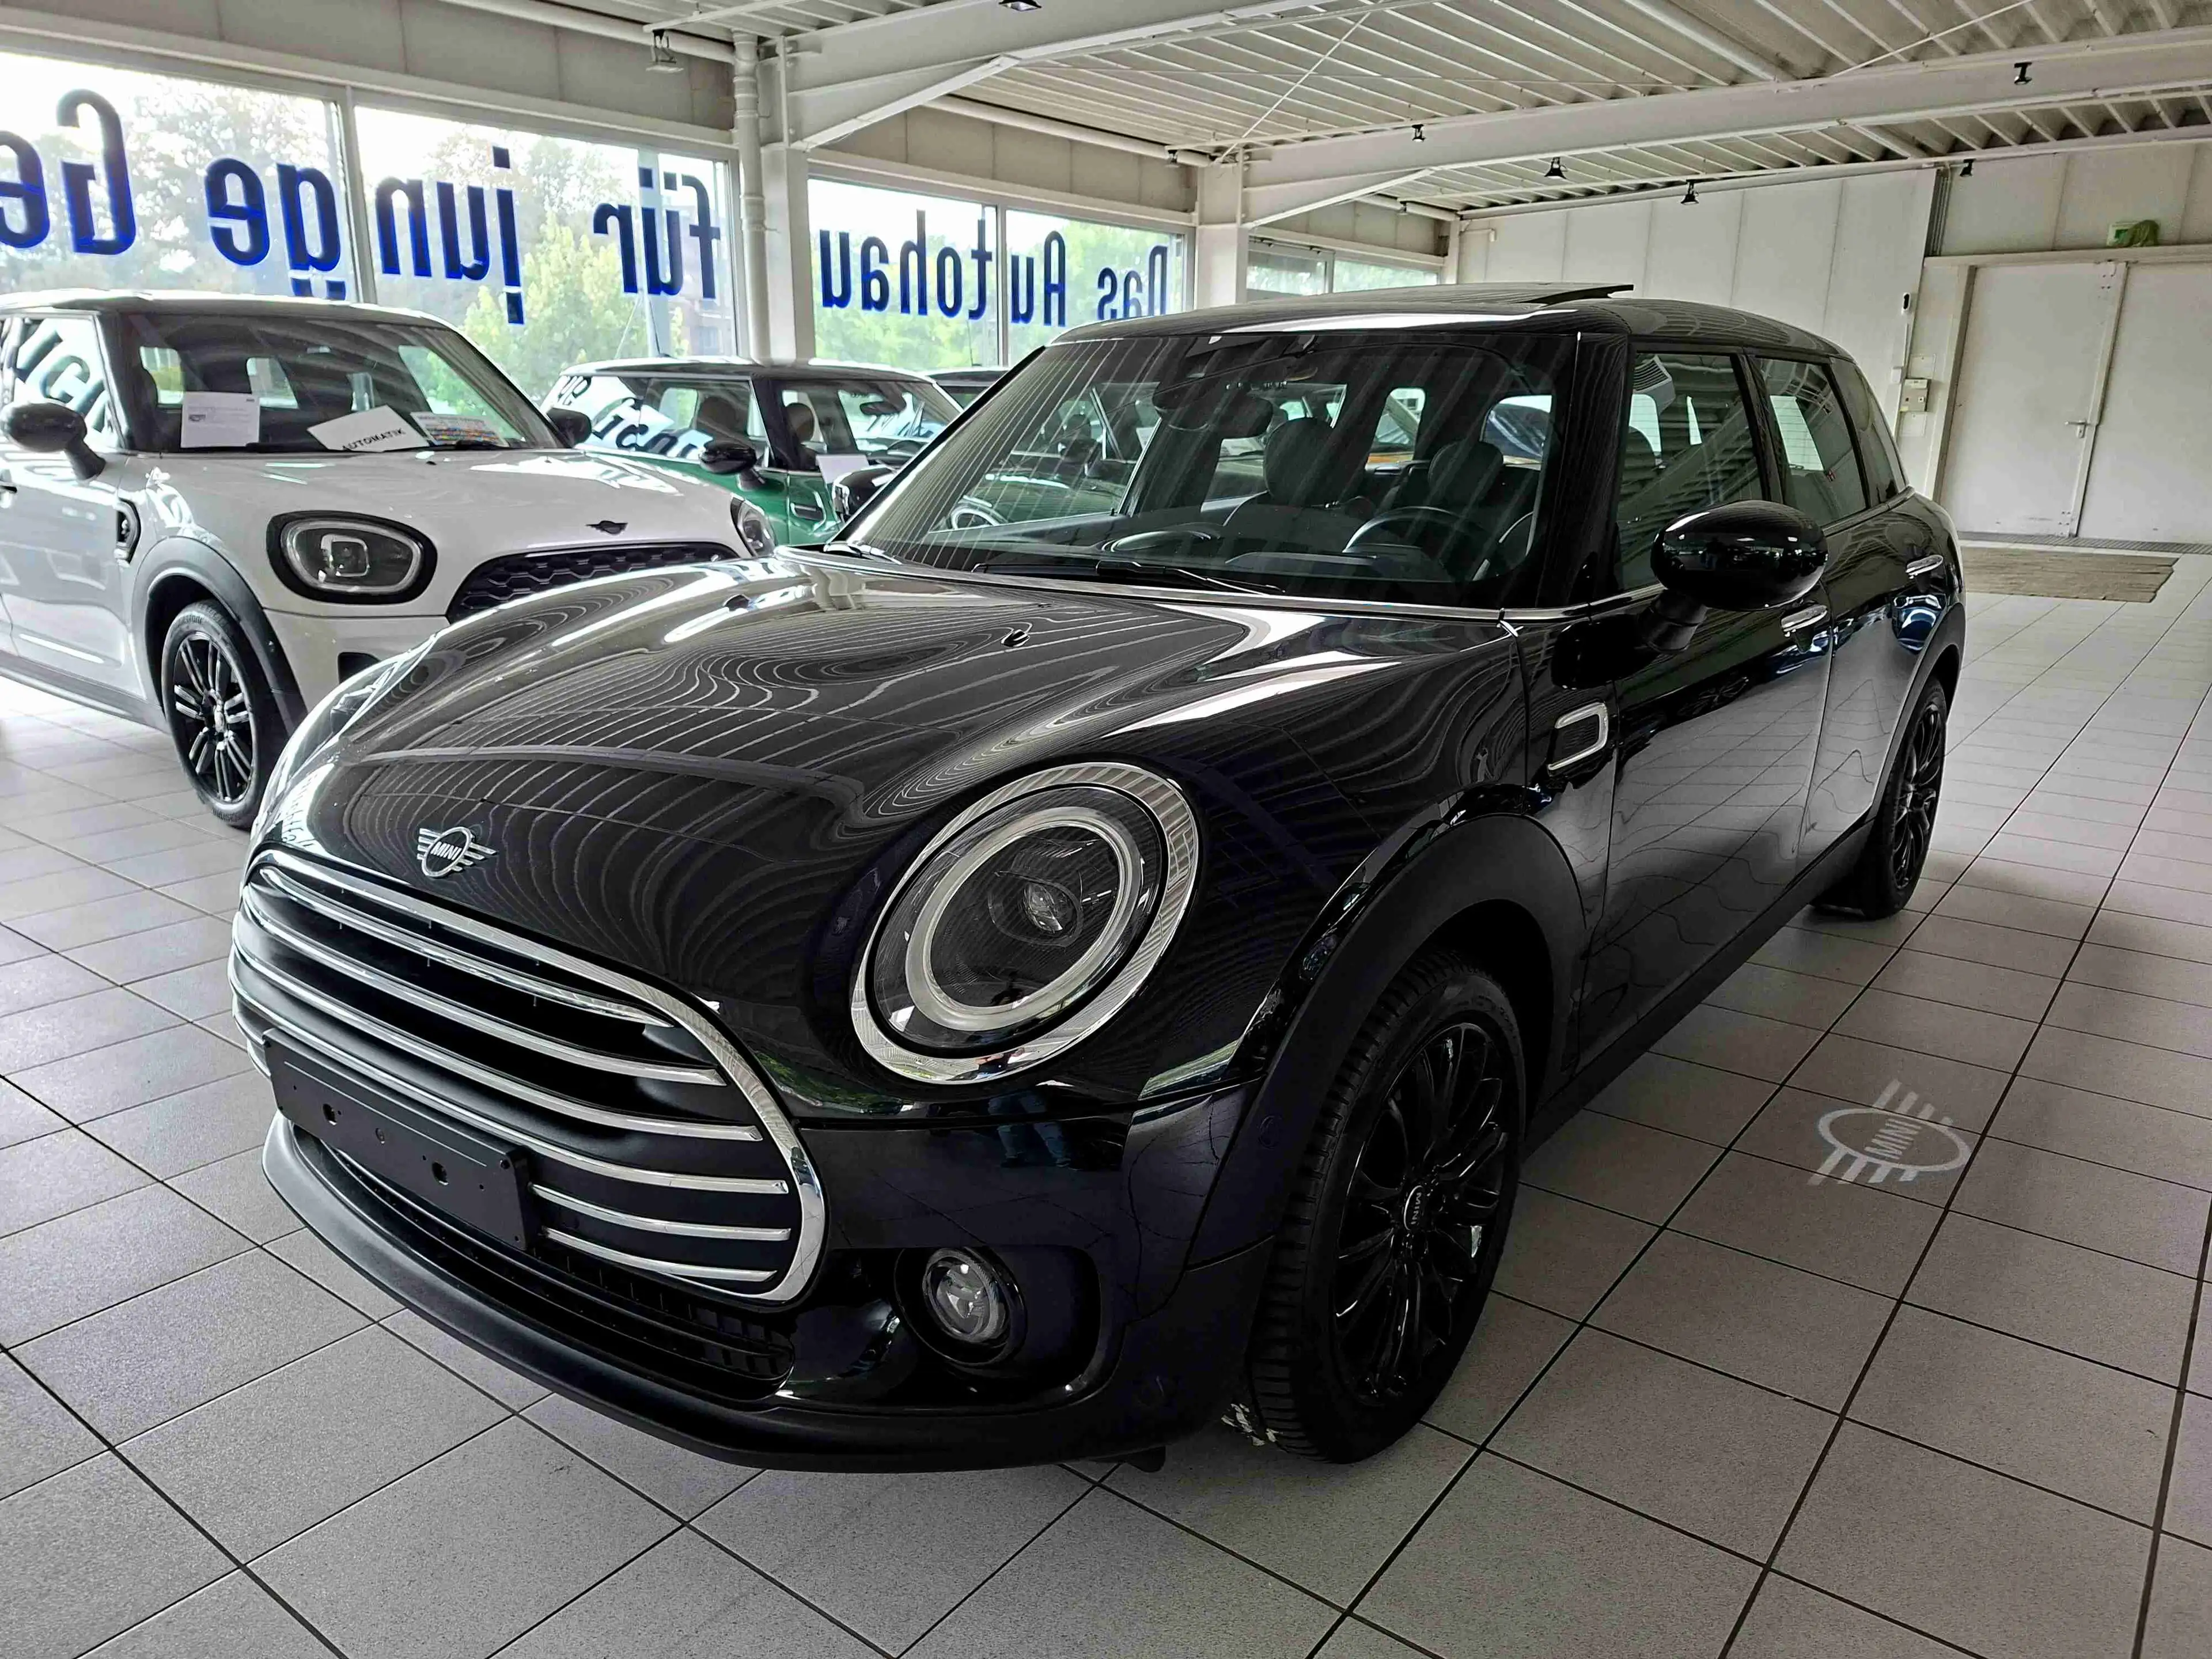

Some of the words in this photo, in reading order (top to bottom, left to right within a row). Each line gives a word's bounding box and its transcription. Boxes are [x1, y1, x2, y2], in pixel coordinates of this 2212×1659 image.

[430, 842, 462, 861] MINI
[1864, 1118, 1922, 1160] MINI
[1411, 1192, 1422, 1225] MINI
